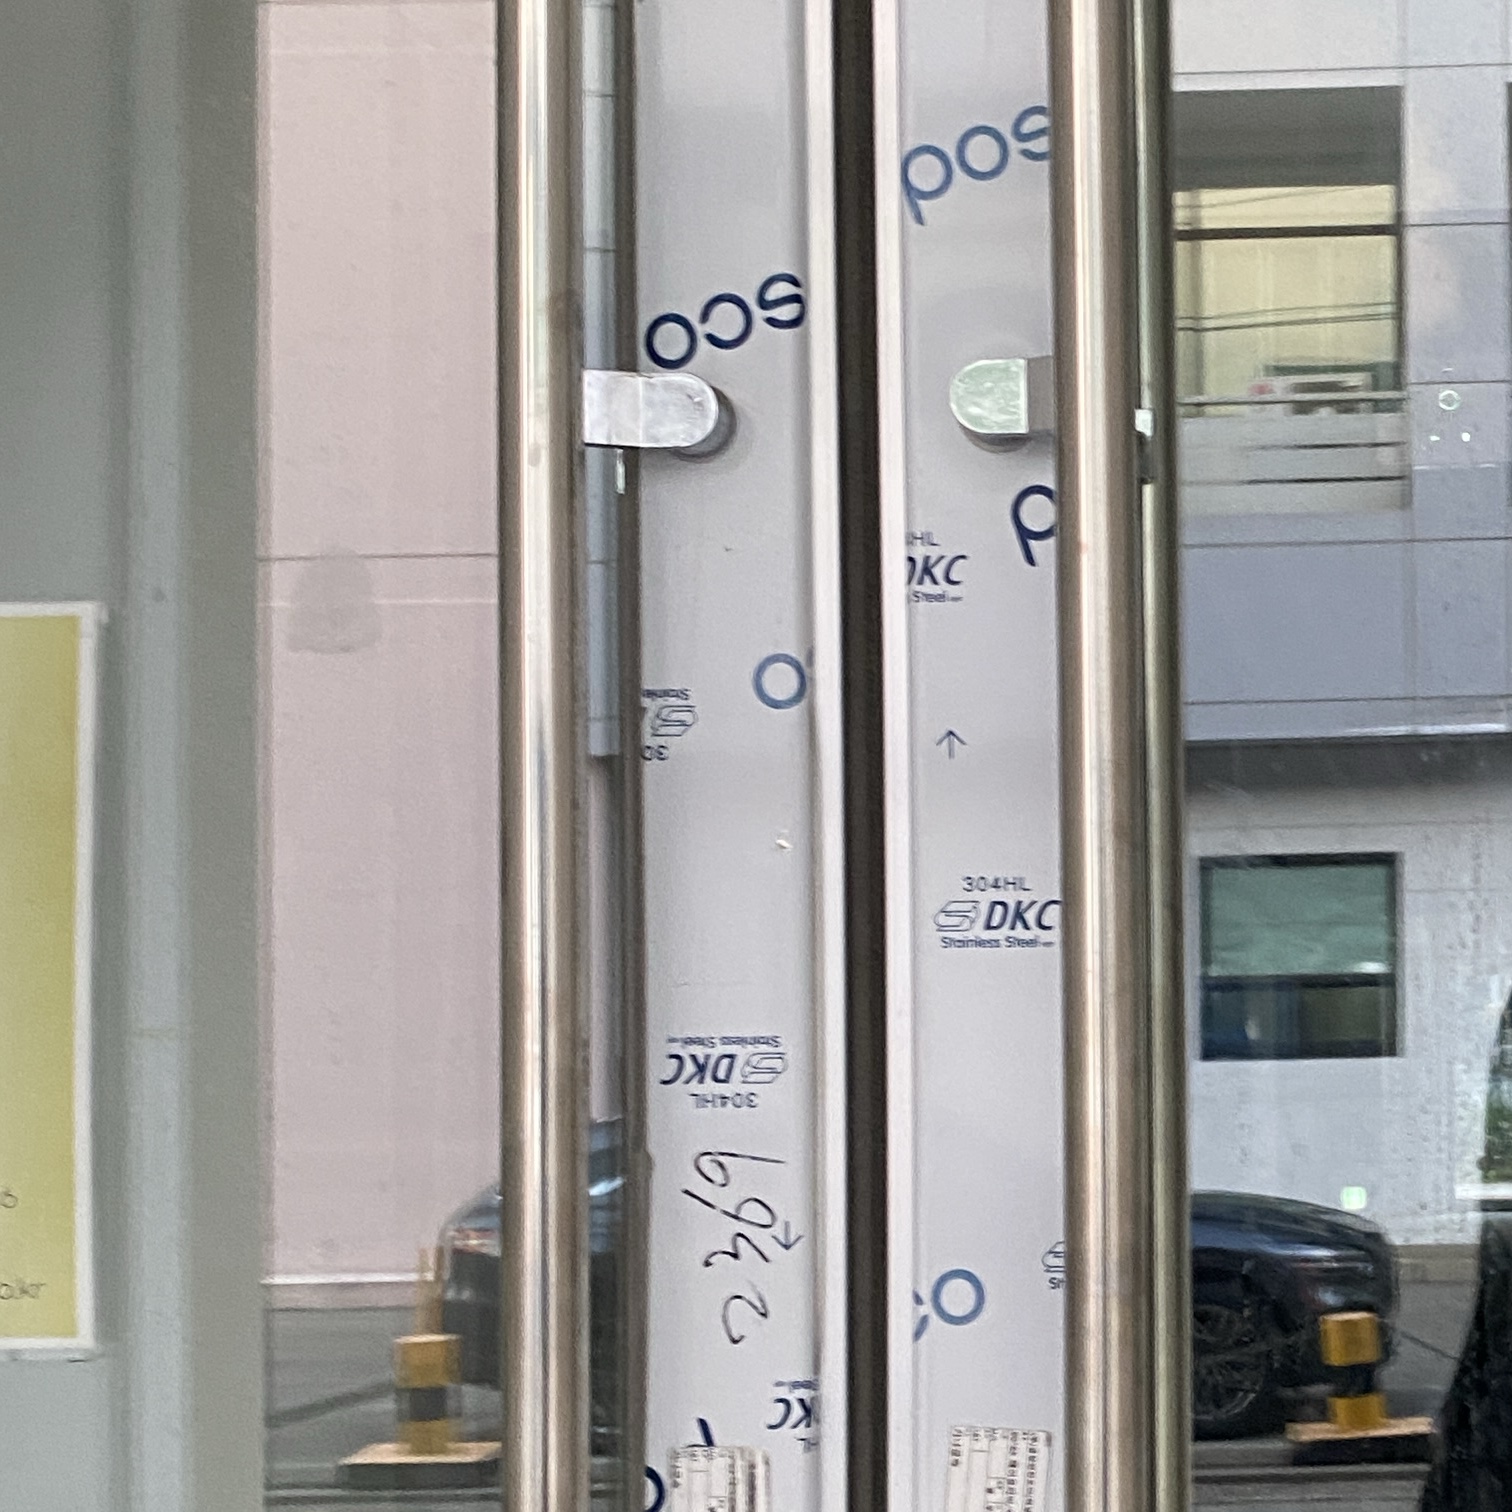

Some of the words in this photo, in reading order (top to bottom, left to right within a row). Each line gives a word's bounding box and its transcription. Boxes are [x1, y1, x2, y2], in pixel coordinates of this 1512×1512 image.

[961, 876, 1033, 892] 304HL
[982, 899, 1062, 931] DKC
[658, 1052, 739, 1086] DKC
